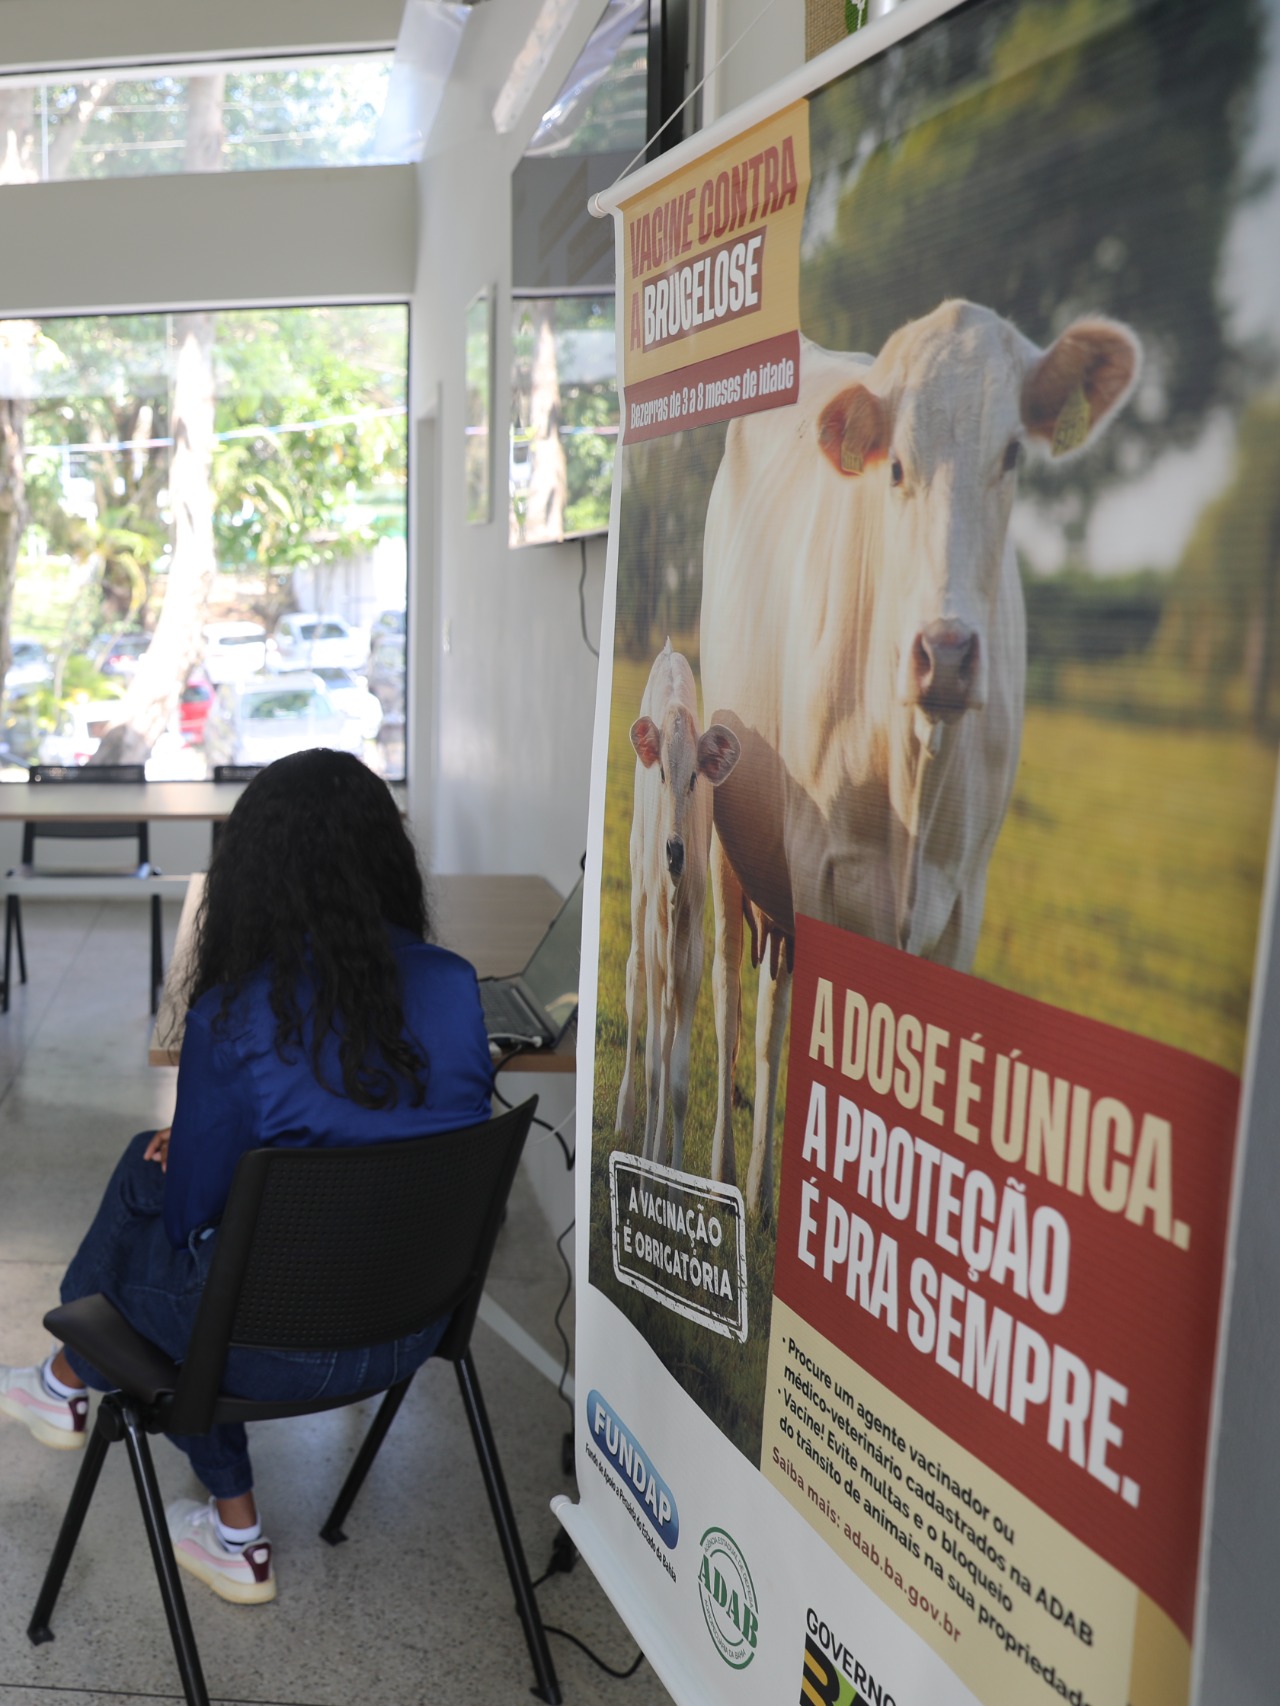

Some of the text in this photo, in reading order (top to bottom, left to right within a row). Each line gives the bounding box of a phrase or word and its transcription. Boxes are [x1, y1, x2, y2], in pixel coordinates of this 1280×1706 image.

[630, 135, 798, 280] VACINE CONTRA
[630, 234, 762, 351] A BRUCELOSE
[631, 357, 795, 429] Bezerras de 3 a 8 meses de idade
[801, 1080, 1071, 1316] A PROTEÇÃO
[808, 976, 1191, 1252] A DOSE É ÚNICA.
[623, 1218, 733, 1301] É OBRIGATÓRIA
[629, 1186, 723, 1248] A VACINAÇÃO
[797, 1176, 1141, 1510] É PRA SEMPRE.
[585, 1442, 598, 1468] Fundo
[603, 1468, 616, 1491] Apoio
[641, 1523, 656, 1553] Estado
[662, 1554, 677, 1584] Bahia
[592, 1401, 673, 1528] FUNDAP
[779, 1415, 795, 1440] do
[795, 1427, 842, 1486] trânsito
[844, 1474, 862, 1504] de
[863, 1496, 921, 1559] animais
[923, 1550, 945, 1580] na
[947, 1573, 976, 1611] sua
[783, 1387, 1014, 1614] Vacine! Evite multas e o bloqueio
[783, 1363, 1095, 1648] médico-veterinário cadastrados na ADAB
[788, 1337, 1016, 1546] Procure um agente vacinador ou
[698, 1553, 759, 1649] ADAB
[772, 1445, 963, 1644] Saiba mais: adab.ba.gov.br
